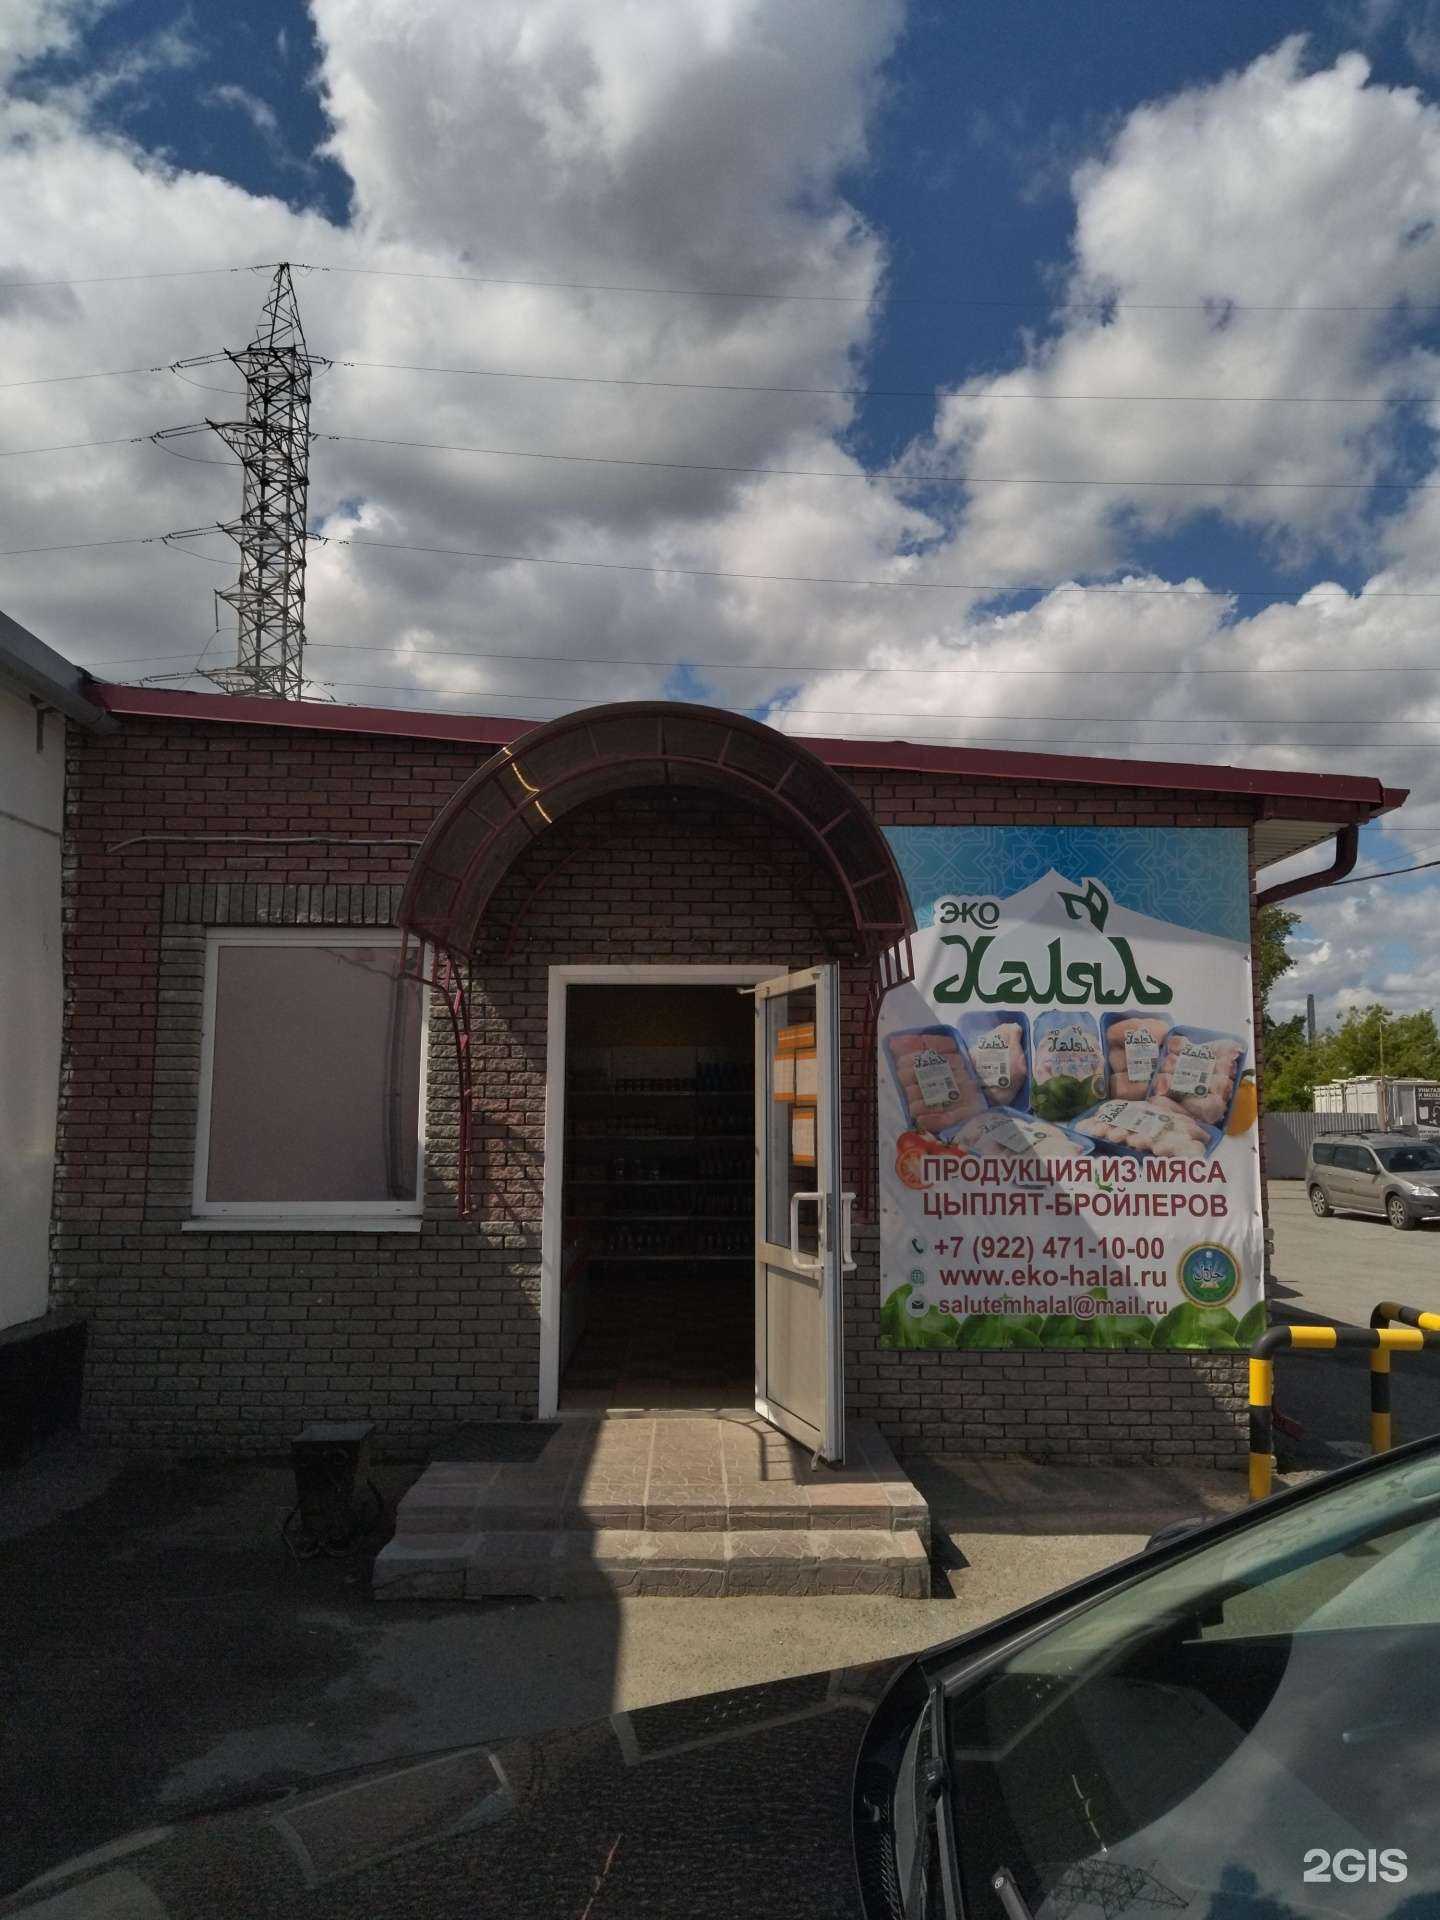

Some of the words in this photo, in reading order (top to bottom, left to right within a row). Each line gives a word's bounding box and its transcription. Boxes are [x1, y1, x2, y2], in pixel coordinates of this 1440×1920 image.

[923, 1158, 1092, 1186] ПРОДУКЦИЯ
[1102, 1159, 1136, 1183] ИЗ
[1149, 1160, 1227, 1184] МЯСА
[923, 1187, 1228, 1220] ЦЫПЛЯТ-БРОЙЛЕРОВ
[934, 1237, 964, 1258] +7
[972, 1236, 1034, 1264] (922)
[1042, 1237, 1165, 1259] 471-10-00
[939, 1265, 1167, 1288] www.eko-halal.ru
[938, 1296, 1168, 1318] salutemhalal@mail.ru
